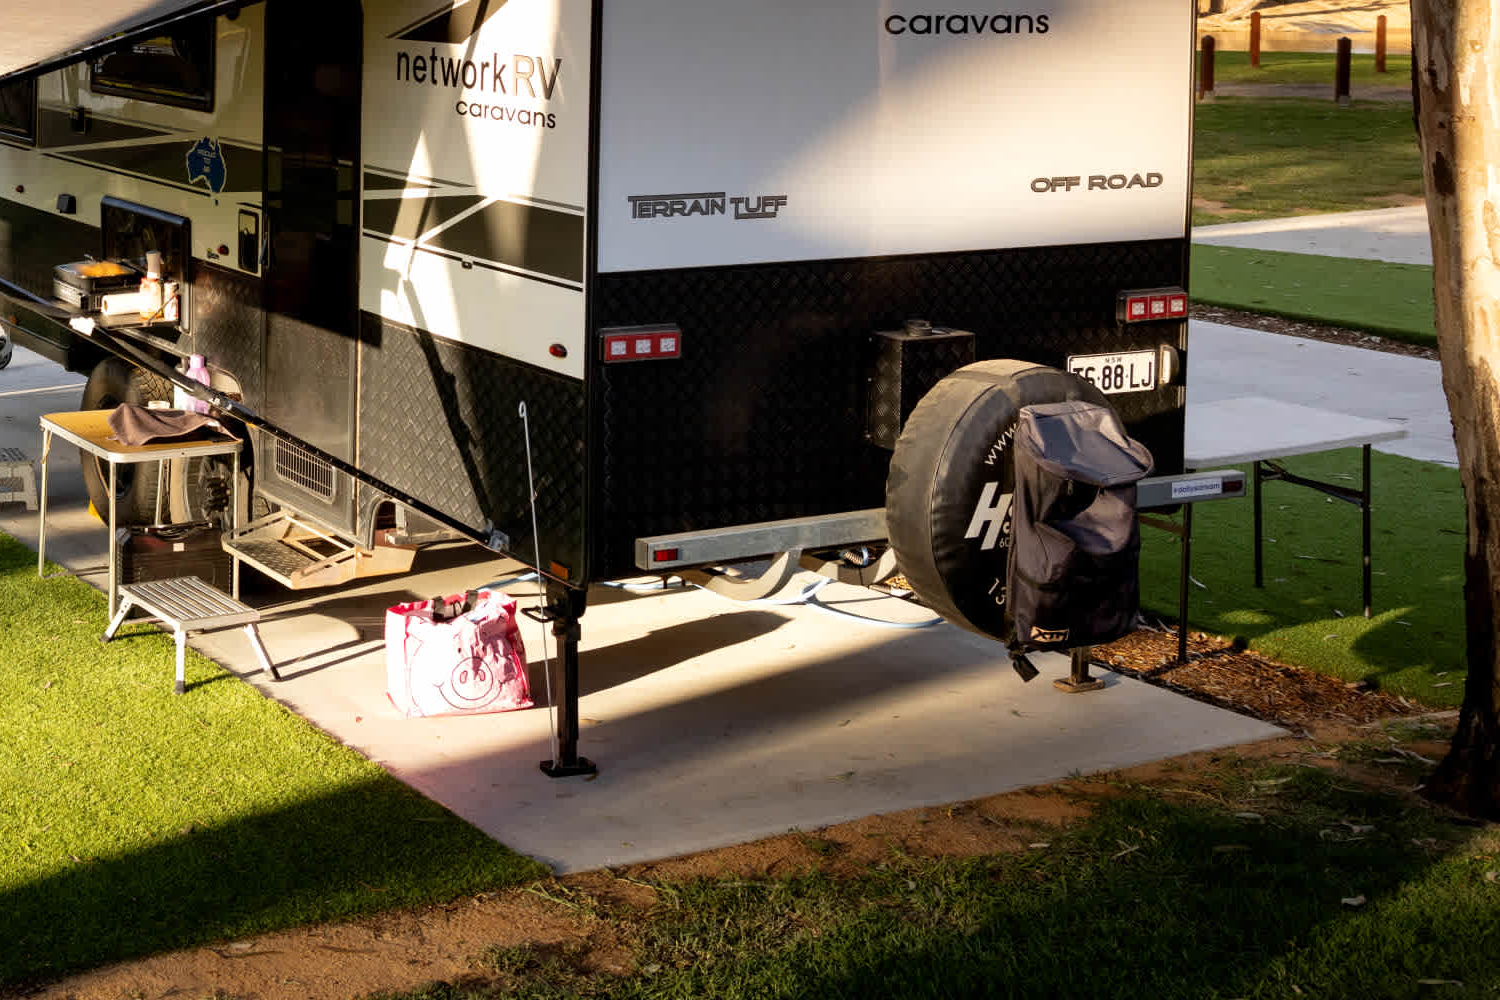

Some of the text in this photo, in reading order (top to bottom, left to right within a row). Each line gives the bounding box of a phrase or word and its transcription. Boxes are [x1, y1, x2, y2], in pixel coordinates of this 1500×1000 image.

[884, 10, 1050, 35] caravans
[455, 100, 557, 129] caravans
[1030, 172, 1164, 193] OFF ROAD
[627, 192, 788, 220] TERRAIN TUFF
